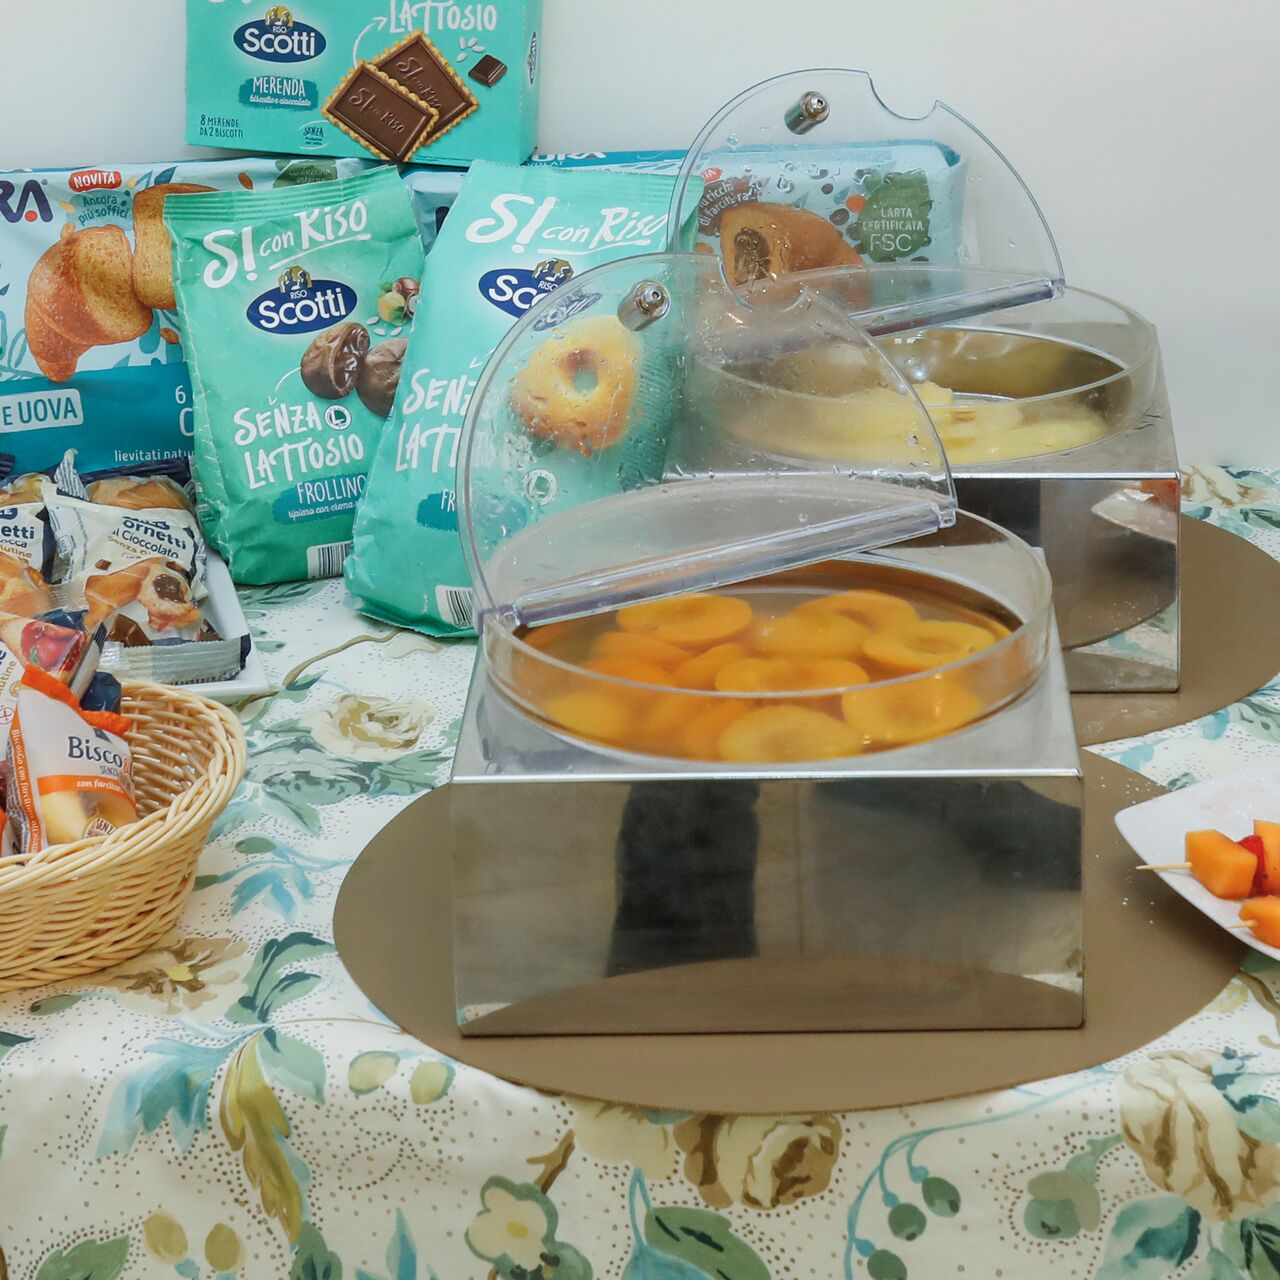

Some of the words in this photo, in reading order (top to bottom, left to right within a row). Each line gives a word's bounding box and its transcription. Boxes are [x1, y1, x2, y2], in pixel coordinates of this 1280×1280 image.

[390, 0, 497, 33] LATTOSIO
[243, 28, 315, 56] Scotti
[253, 77, 305, 97] MERENDA
[200, 114, 206, 125] 8
[207, 116, 239, 127] MERENDE
[200, 127, 208, 136] DA
[209, 127, 215, 137] 2
[215, 128, 244, 139] BISCOTTI
[304, 126, 324, 137] SENZA
[82, 195, 117, 207] Ancora
[95, 205, 129, 219] soffici
[465, 194, 557, 253] S!
[543, 225, 589, 243] con
[870, 233, 912, 251] FSC
[203, 225, 256, 289] S!
[260, 230, 295, 257] con
[289, 289, 308, 300] RISO
[258, 287, 346, 329] Scotti
[175, 385, 186, 404] 6
[2, 406, 12, 426] E
[17, 396, 78, 423] UOVA
[234, 401, 322, 446] SENZA
[114, 449, 160, 461] lievitati
[245, 434, 364, 490] LATTOSIO
[316, 505, 329, 513] con
[18, 767, 26, 782] con
